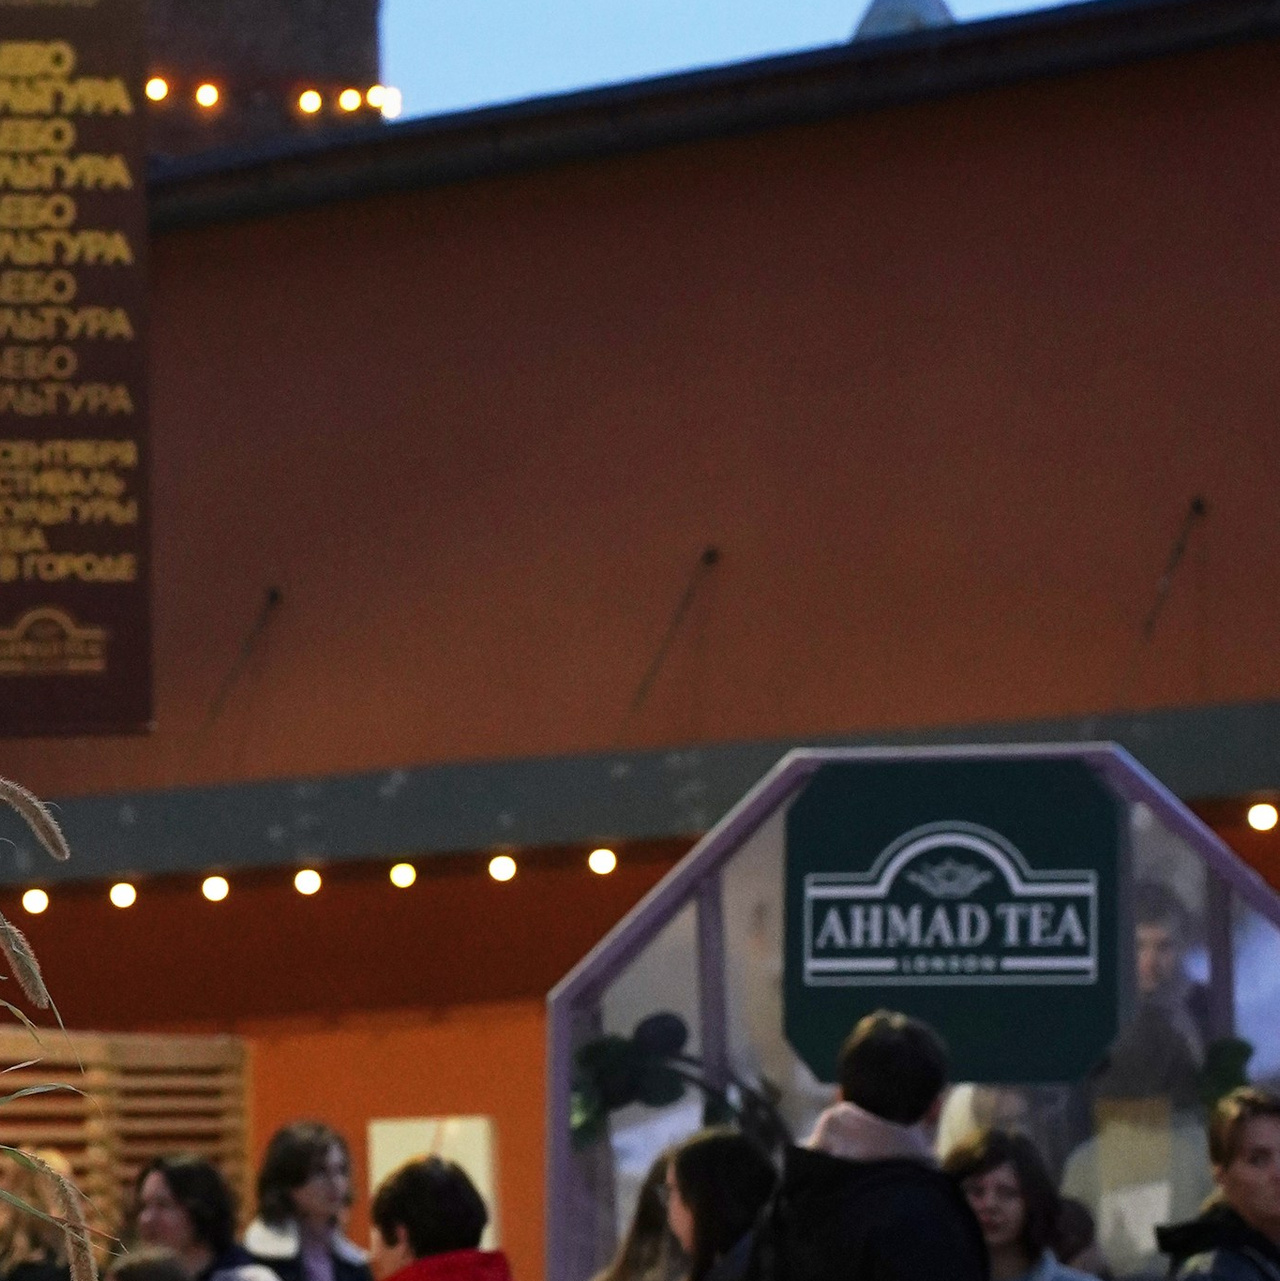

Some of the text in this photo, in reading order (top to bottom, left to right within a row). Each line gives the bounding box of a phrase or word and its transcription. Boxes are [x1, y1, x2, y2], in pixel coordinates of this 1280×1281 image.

[24, 553, 136, 581] ГОРОДЕ
[816, 903, 1087, 949] AHMAD TEA
